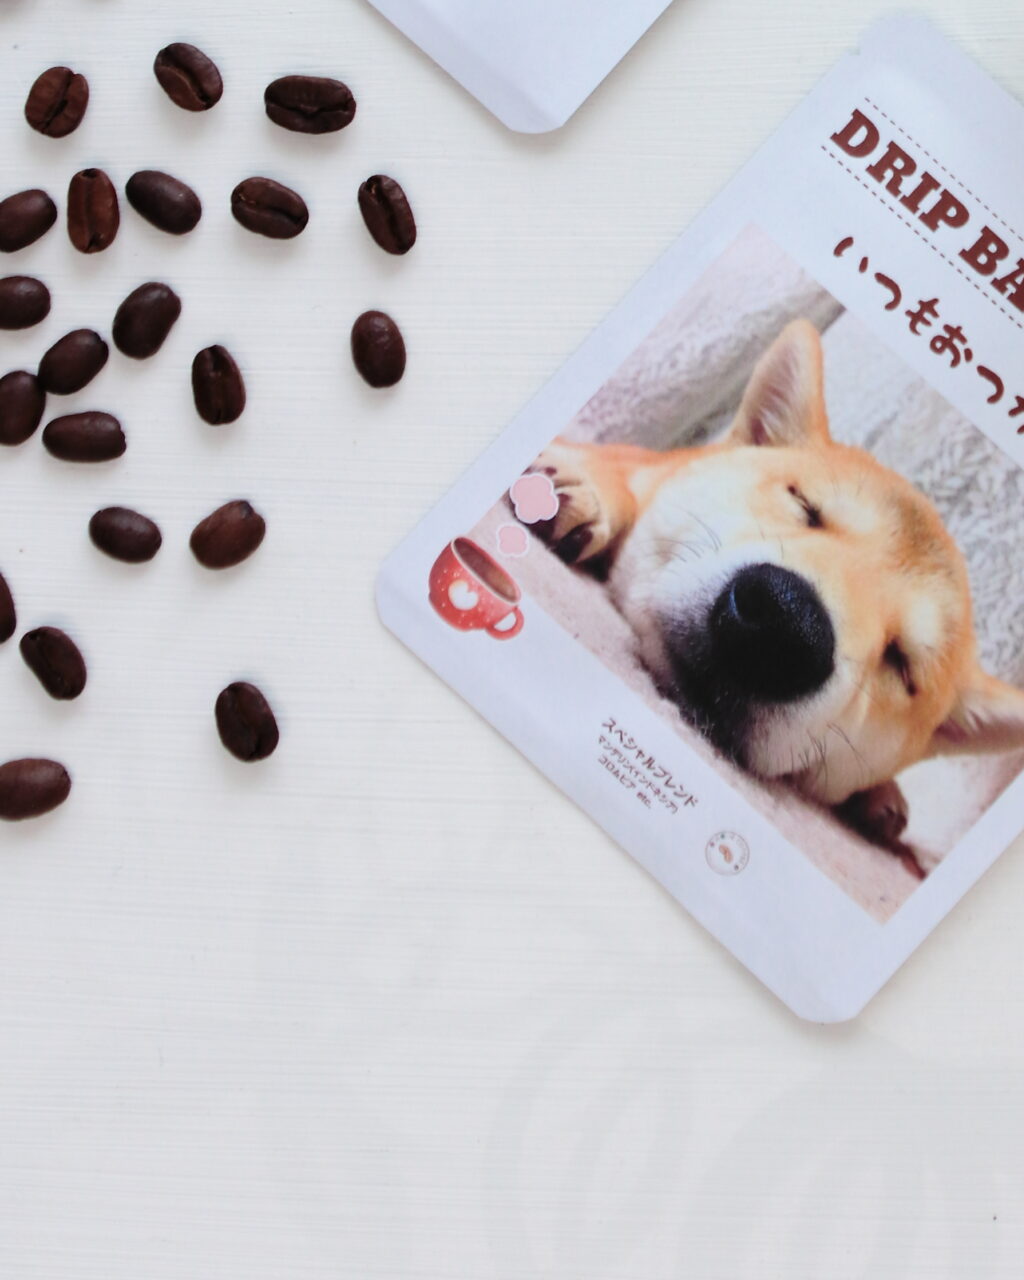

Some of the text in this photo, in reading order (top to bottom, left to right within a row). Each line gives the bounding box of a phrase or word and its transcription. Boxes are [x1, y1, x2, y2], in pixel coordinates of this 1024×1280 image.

[830, 108, 970, 232] DRIP
[602, 717, 698, 807] スペシャルブレンド
